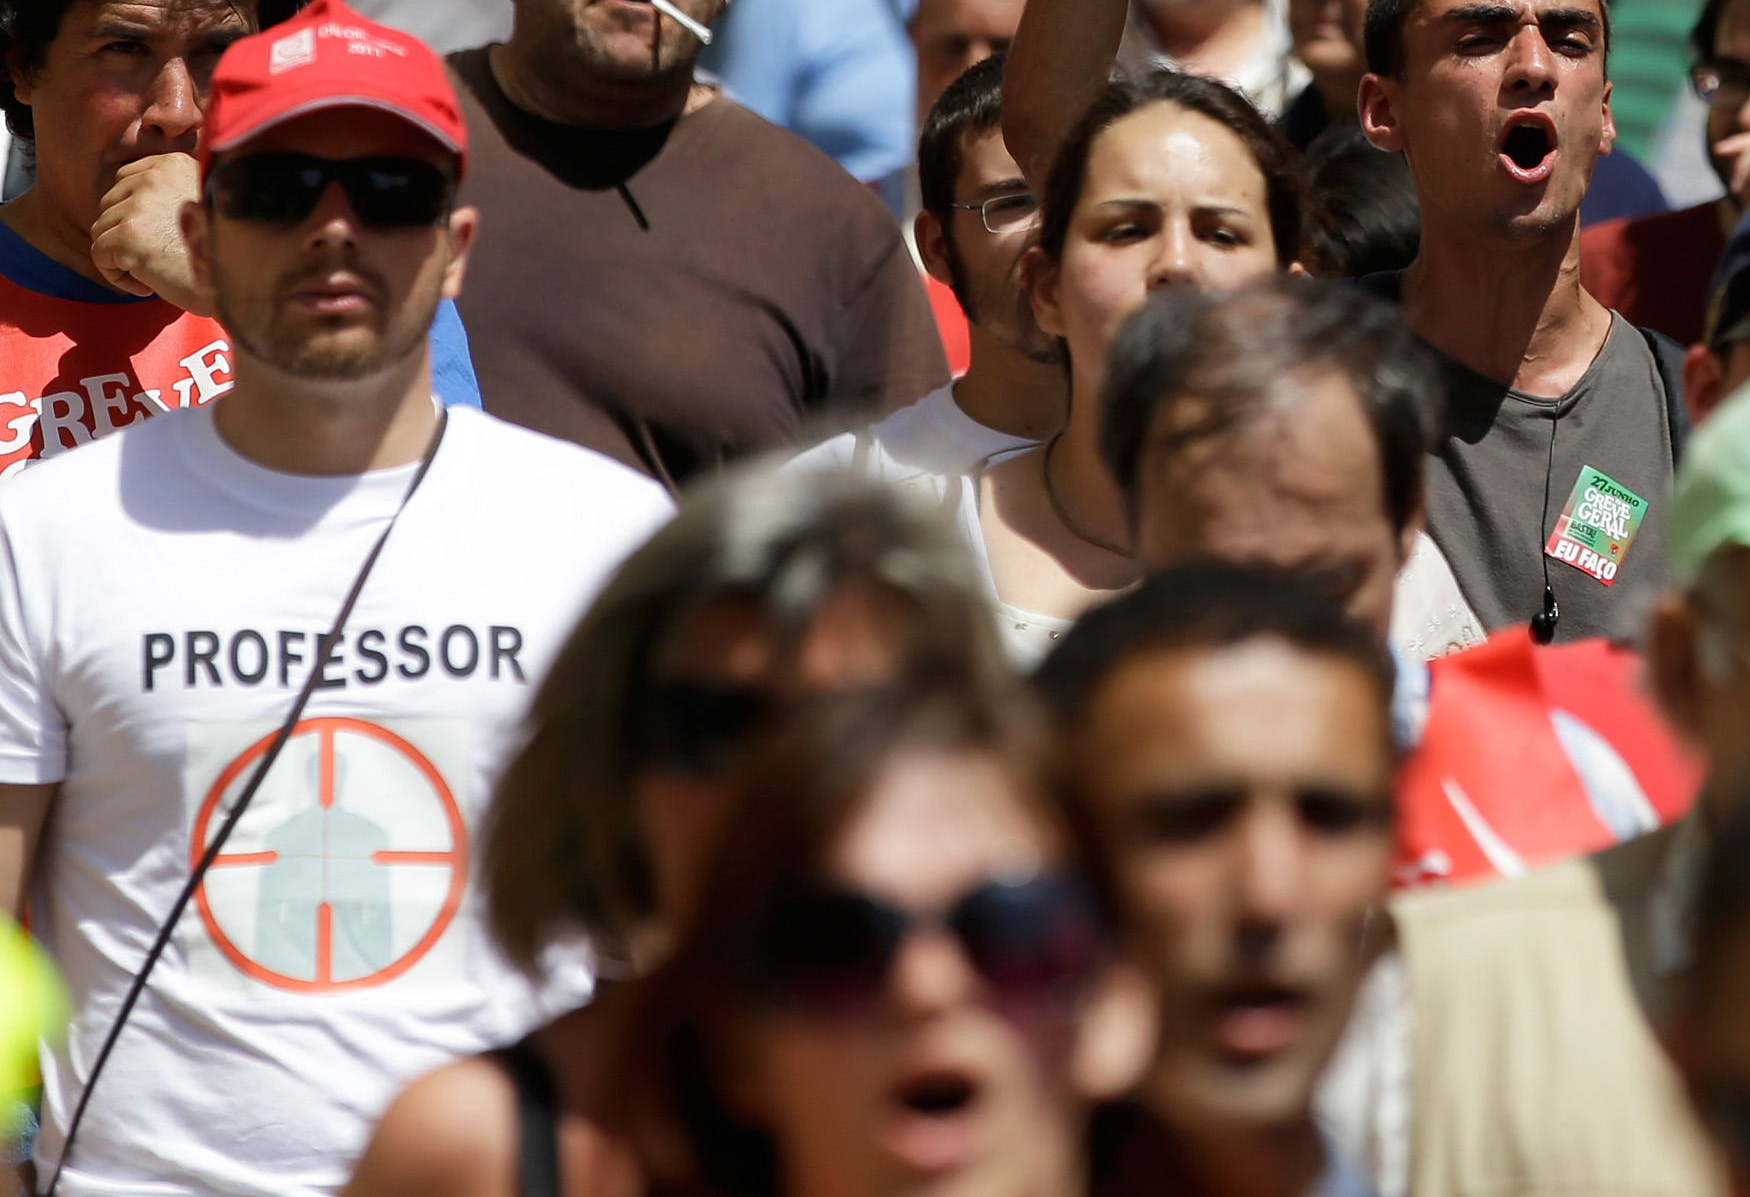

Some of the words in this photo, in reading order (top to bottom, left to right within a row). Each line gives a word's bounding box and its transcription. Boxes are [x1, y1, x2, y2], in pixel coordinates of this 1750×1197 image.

[1584, 487, 1632, 520] GREVE
[1589, 475, 1609, 492] 27
[1603, 484, 1640, 508] JUNHO
[1577, 502, 1629, 542] GERAL
[1553, 539, 1581, 562] EU
[1577, 548, 1618, 580] FAÇO
[141, 624, 527, 693] PROFESSOR
